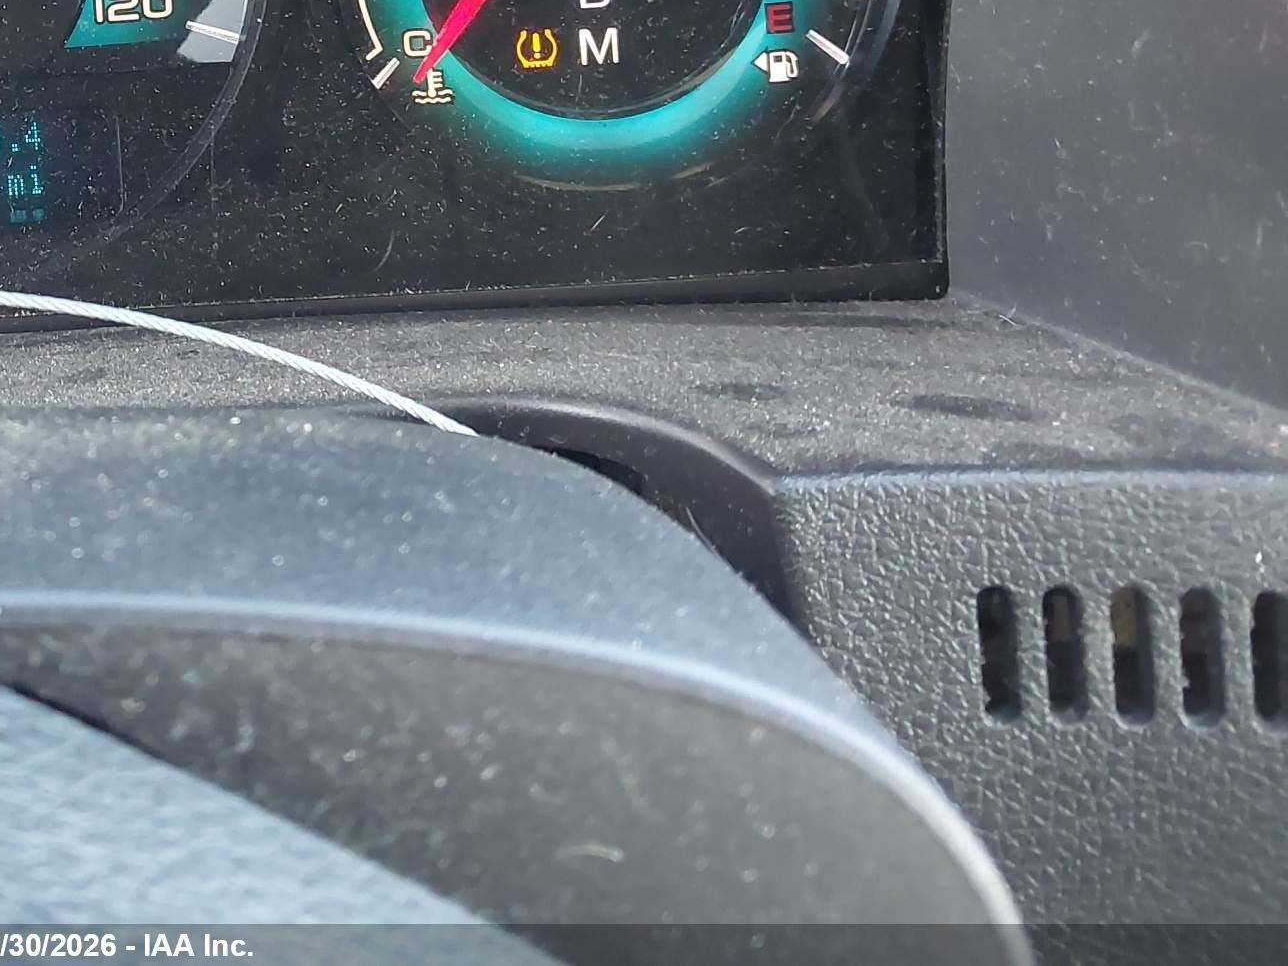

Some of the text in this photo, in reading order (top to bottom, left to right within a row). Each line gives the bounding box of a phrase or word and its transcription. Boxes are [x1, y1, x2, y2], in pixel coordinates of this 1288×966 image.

[767, 2, 793, 33] E
[402, 30, 432, 57] C
[580, 29, 620, 66] M
[7, 164, 42, 197] mi
